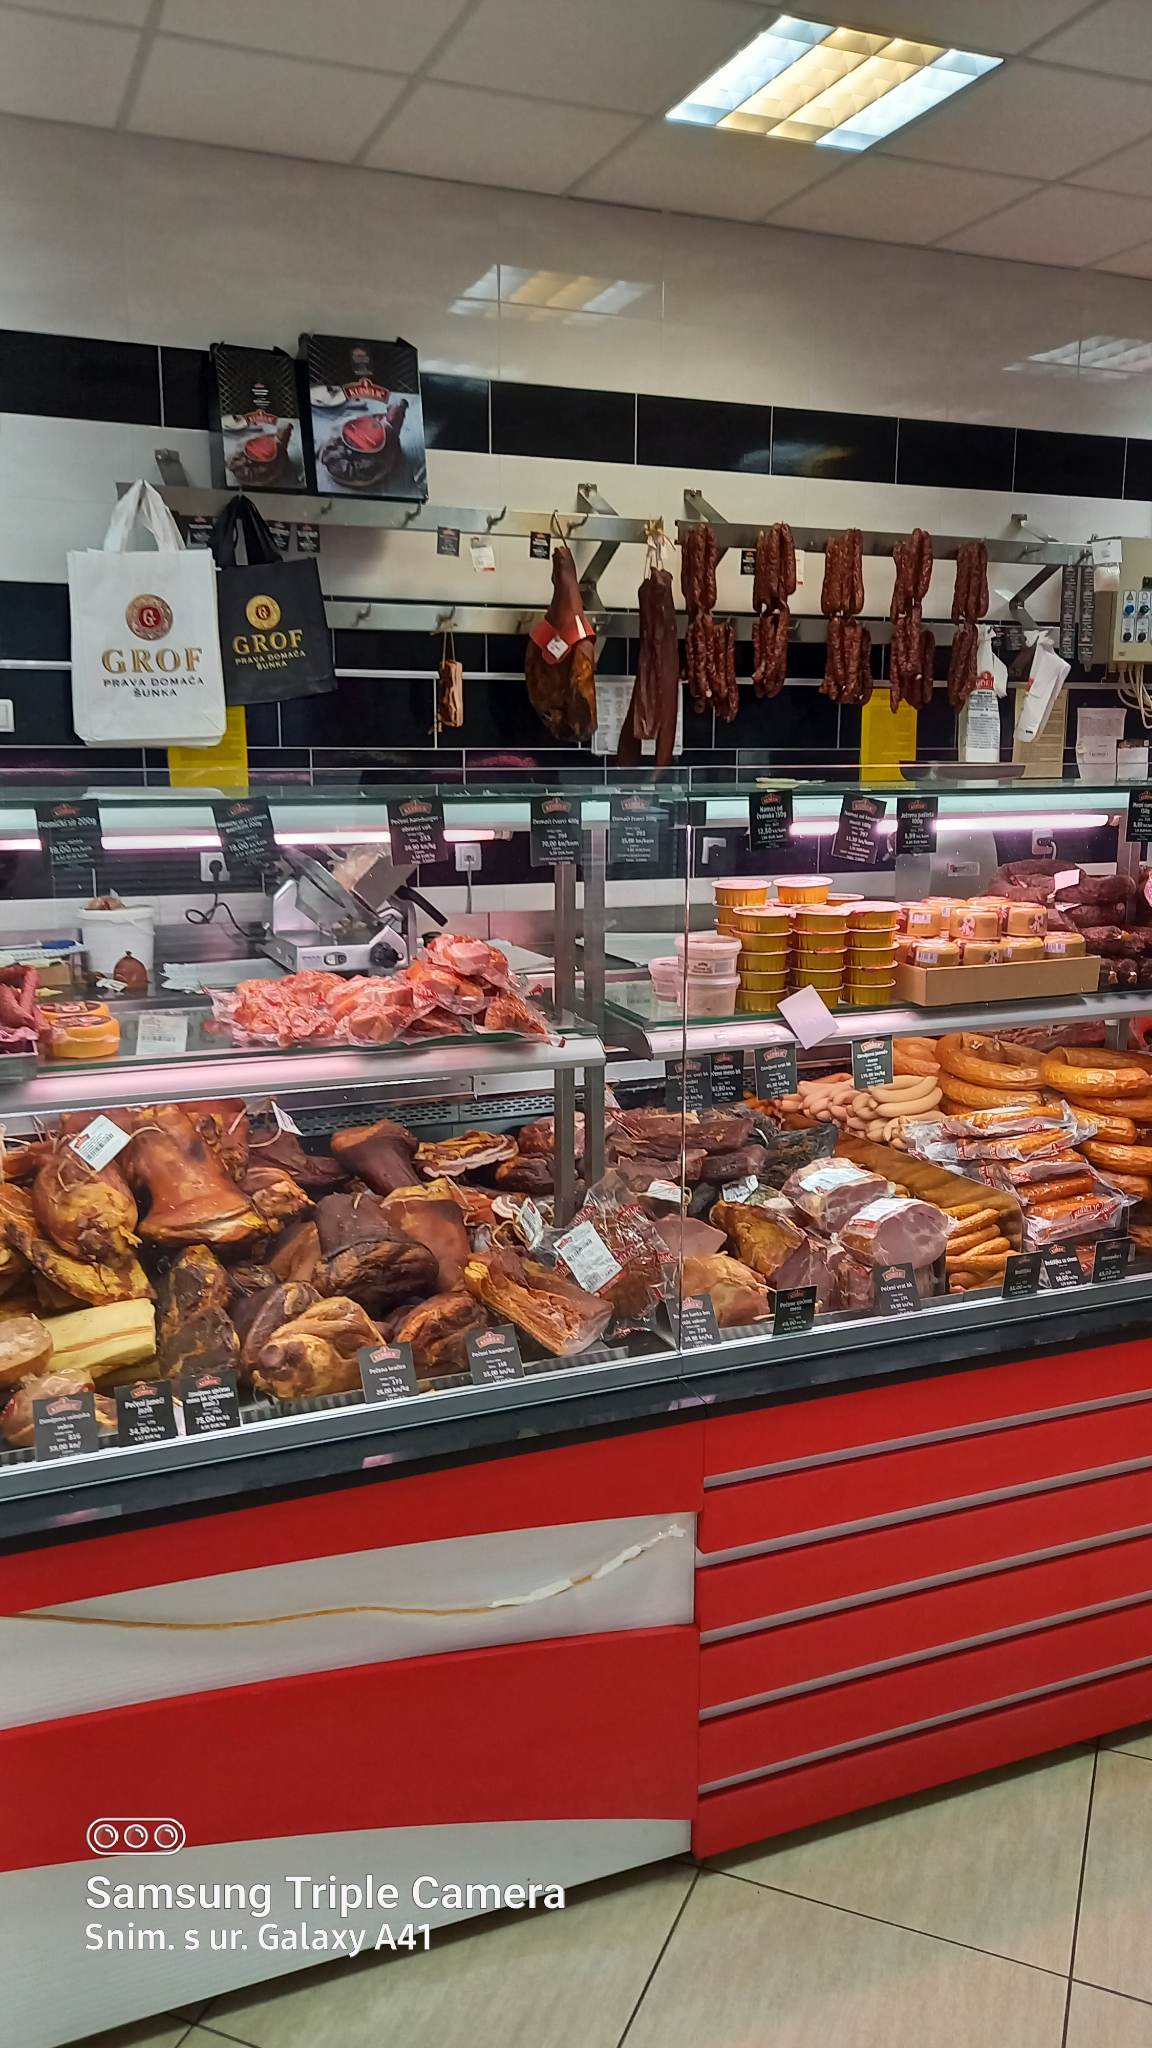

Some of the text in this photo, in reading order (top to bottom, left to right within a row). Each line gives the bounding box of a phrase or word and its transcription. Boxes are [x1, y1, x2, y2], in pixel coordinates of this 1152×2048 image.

[233, 629, 303, 655] GROF
[101, 648, 204, 674] GROF
[235, 651, 306, 666] PRAVA DOMAĆA
[257, 661, 288, 672] ŠUNKA
[104, 676, 205, 689] PRAVA DOMAĆA
[134, 687, 178, 698] ŠUNKA
